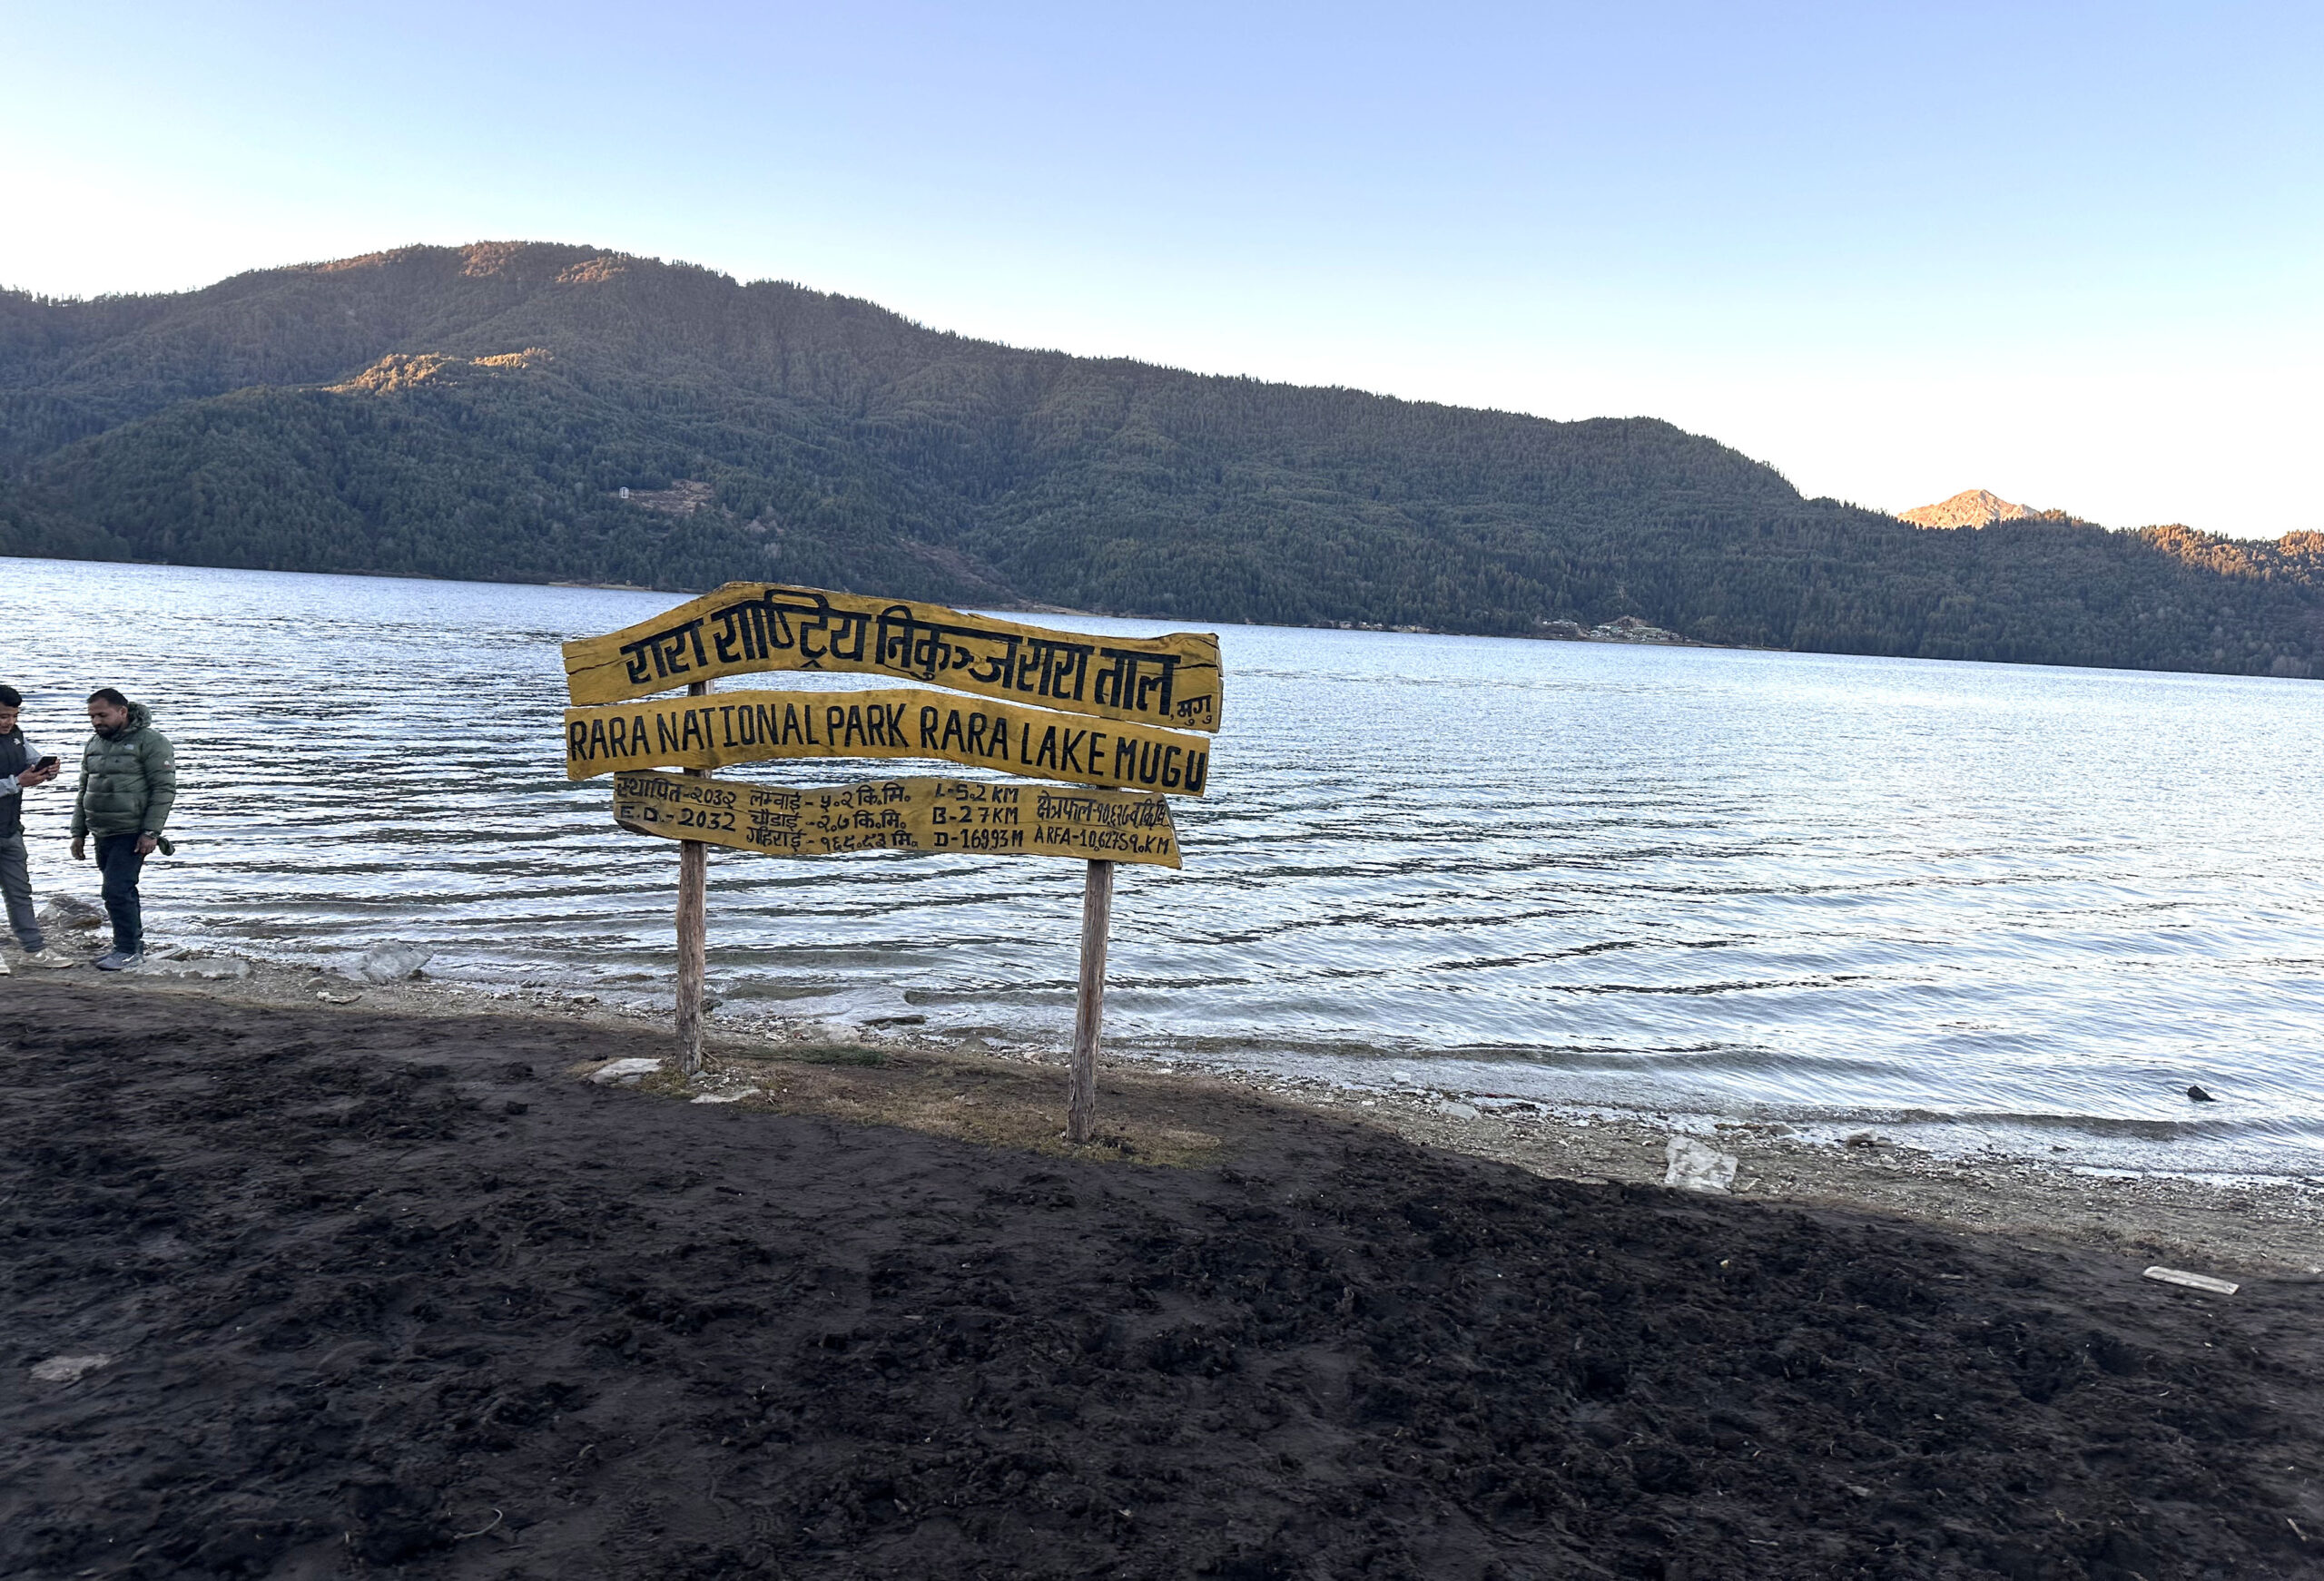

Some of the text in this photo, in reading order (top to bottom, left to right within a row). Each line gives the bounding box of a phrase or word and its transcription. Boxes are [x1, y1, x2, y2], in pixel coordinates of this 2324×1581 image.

[620, 617, 708, 684] रारा
[710, 588, 872, 669] राष्ट्रिय
[875, 604, 1023, 689] निकुञ्ज
[1016, 636, 1094, 702] रारा
[1177, 694, 1212, 726] मुगु
[570, 703, 1206, 791] RARA NATIONAL PARK RARA LAKE MUGU
